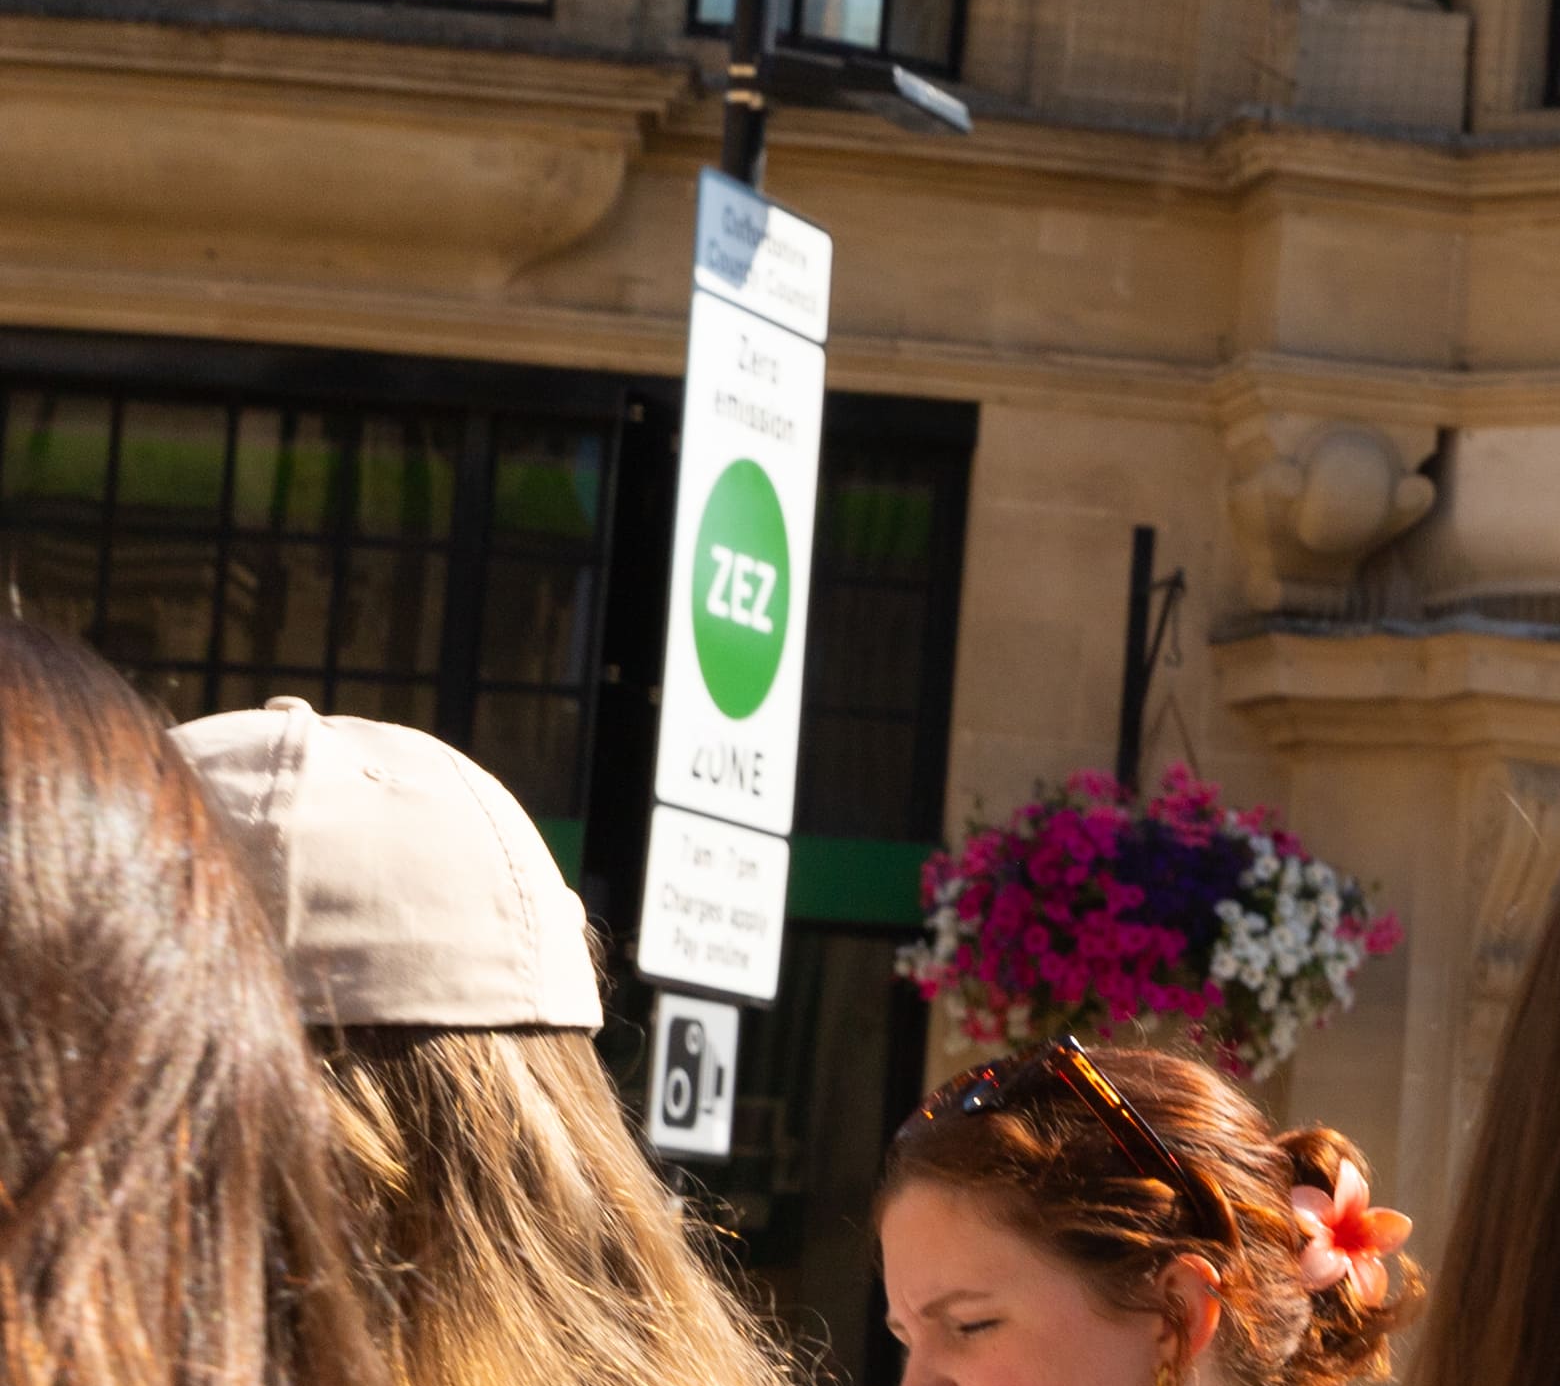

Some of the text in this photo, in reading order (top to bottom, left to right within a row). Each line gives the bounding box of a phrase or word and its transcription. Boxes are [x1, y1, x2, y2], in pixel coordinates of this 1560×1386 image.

[737, 333, 780, 387] Zero
[713, 386, 797, 447] emission
[705, 542, 778, 637] ZEZ
[692, 743, 764, 797] ZONE
